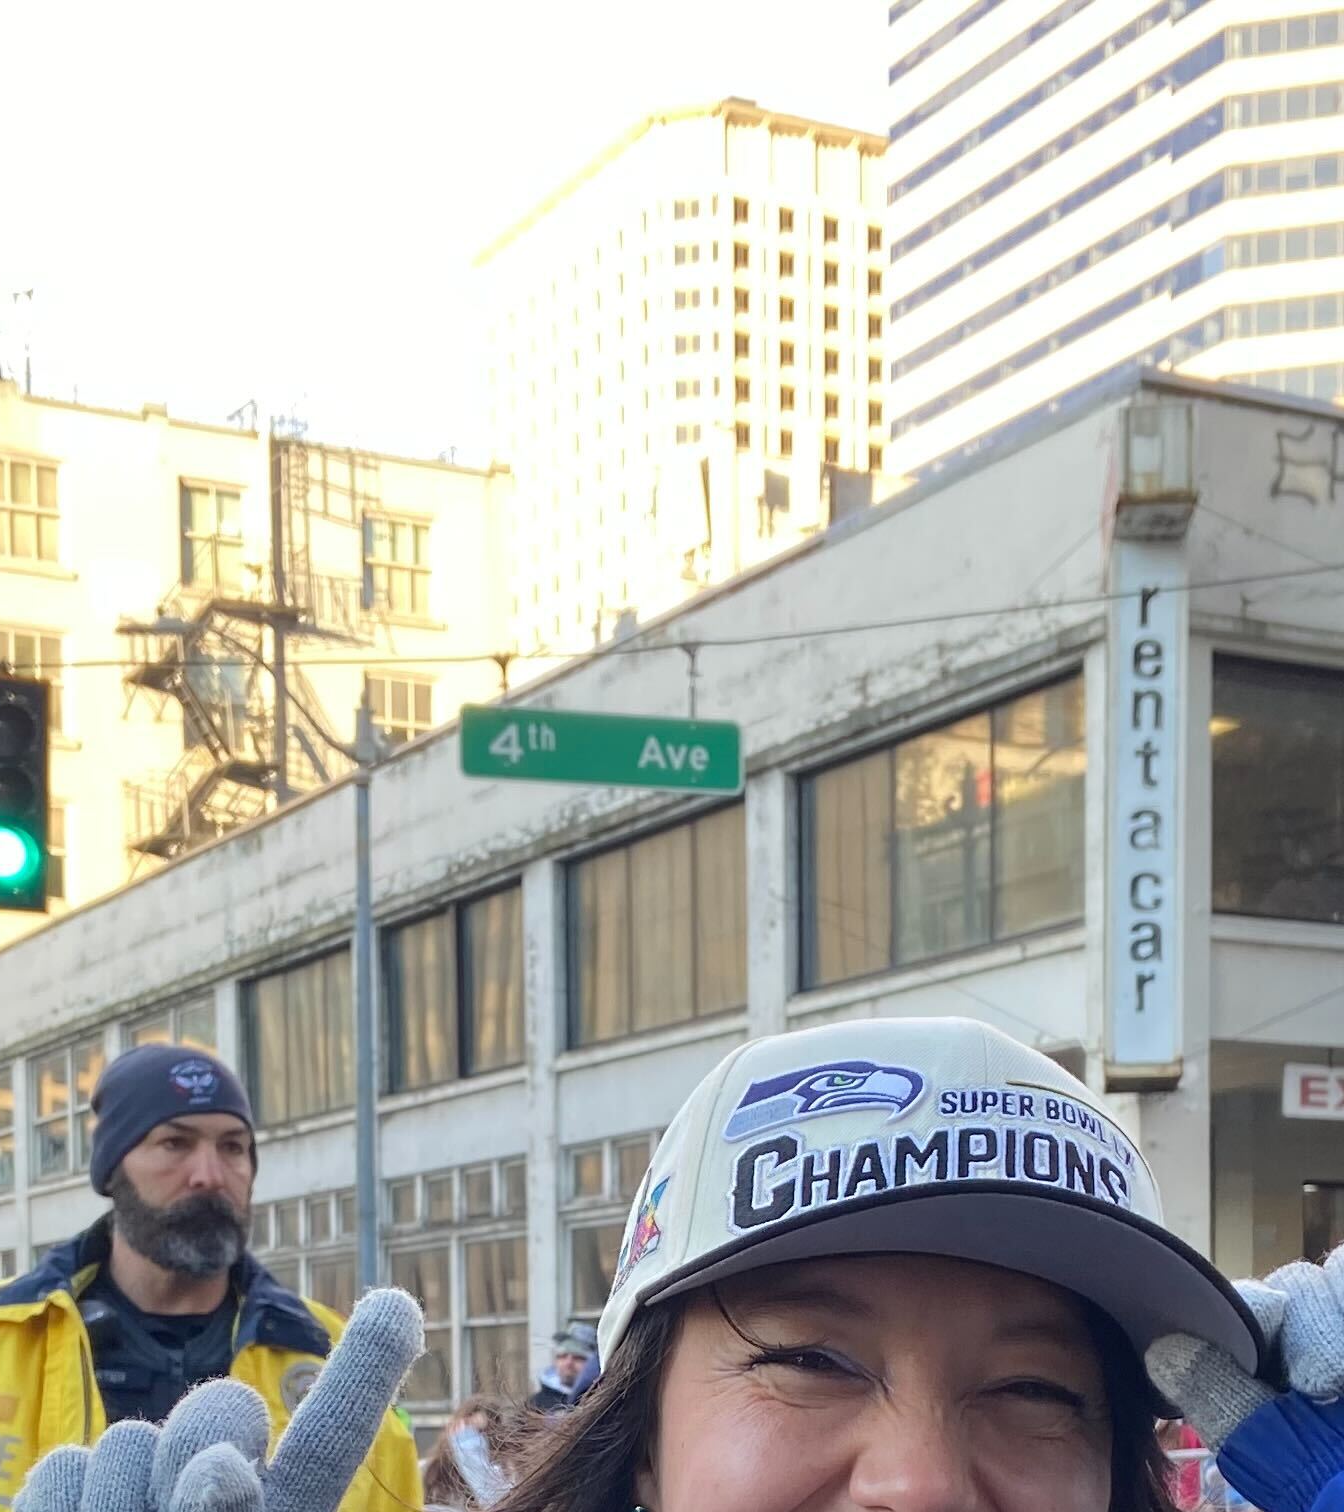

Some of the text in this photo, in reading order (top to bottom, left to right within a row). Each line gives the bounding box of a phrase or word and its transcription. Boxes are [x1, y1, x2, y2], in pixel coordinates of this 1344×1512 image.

[488, 722, 710, 771] 4th Ave
[1130, 586, 1164, 1013] rent a car
[940, 1089, 1035, 1117] SUPER
[1045, 1098, 1106, 1144] BOWL
[733, 1128, 1128, 1230] CHAMPIONS
